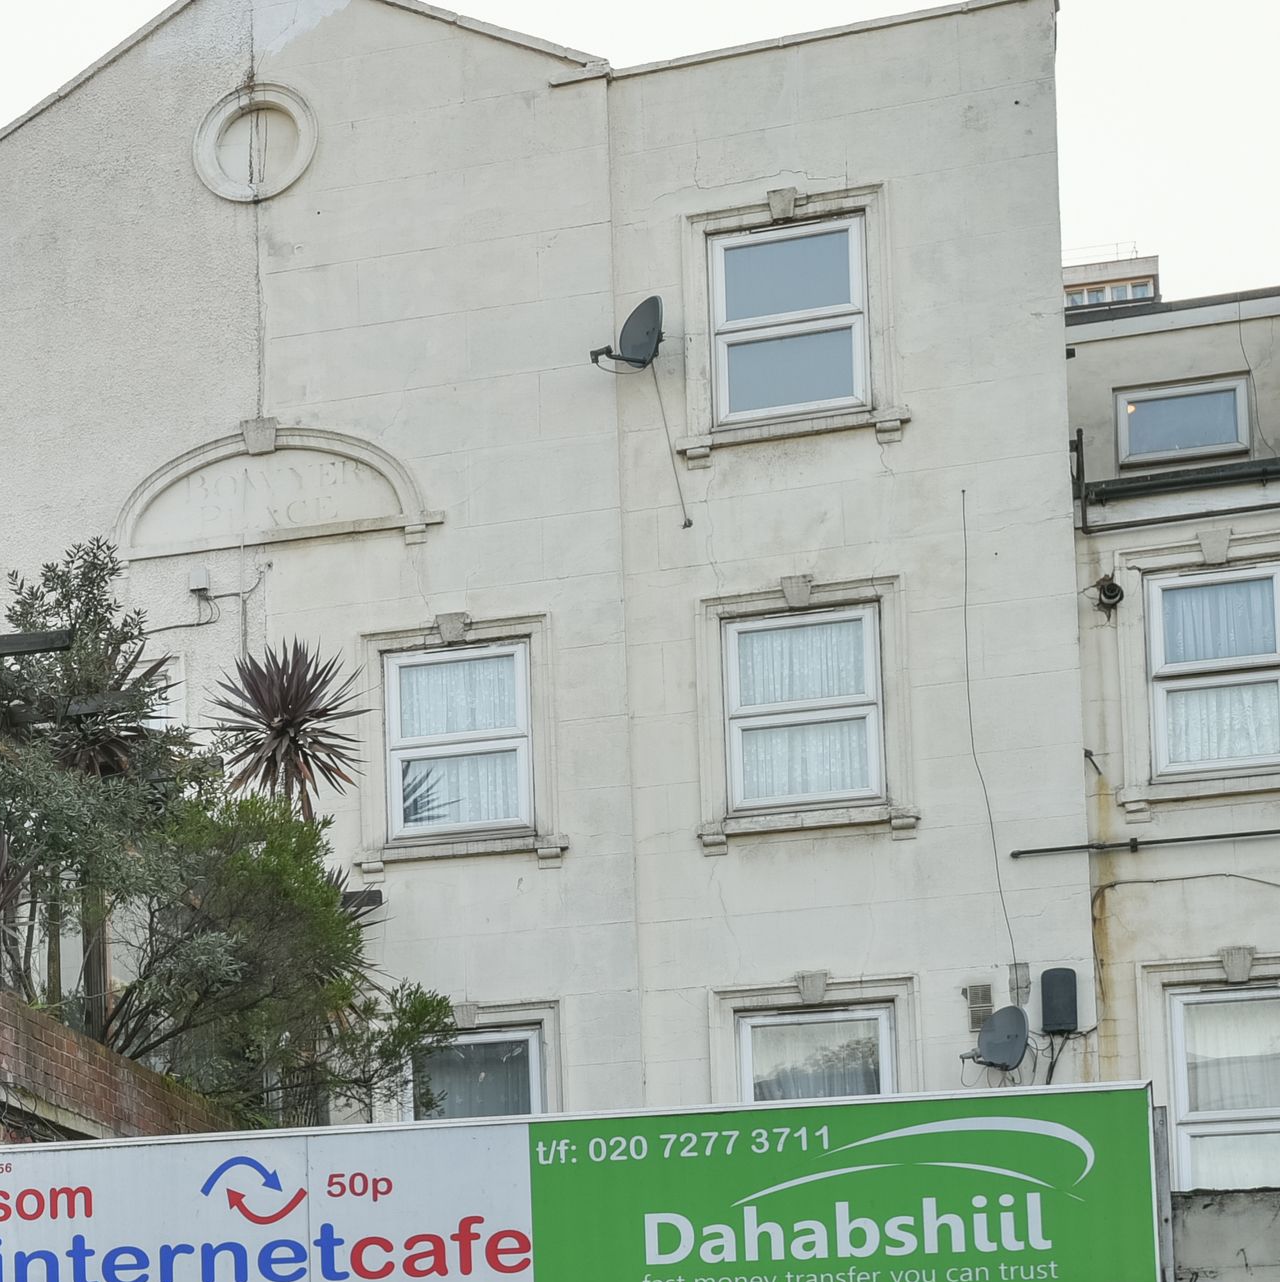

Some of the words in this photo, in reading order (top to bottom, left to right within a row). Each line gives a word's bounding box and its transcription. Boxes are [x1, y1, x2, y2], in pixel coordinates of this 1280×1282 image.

[537, 1138, 578, 1166] t/f:
[588, 1135, 649, 1163] 020
[659, 1130, 741, 1158] 7277
[750, 1126, 832, 1155] 3711
[326, 1173, 393, 1201] 50p
[643, 1192, 1053, 1265] Dahabshiil
[947, 1262, 990, 1282] can
[998, 1260, 1059, 1281] trust
